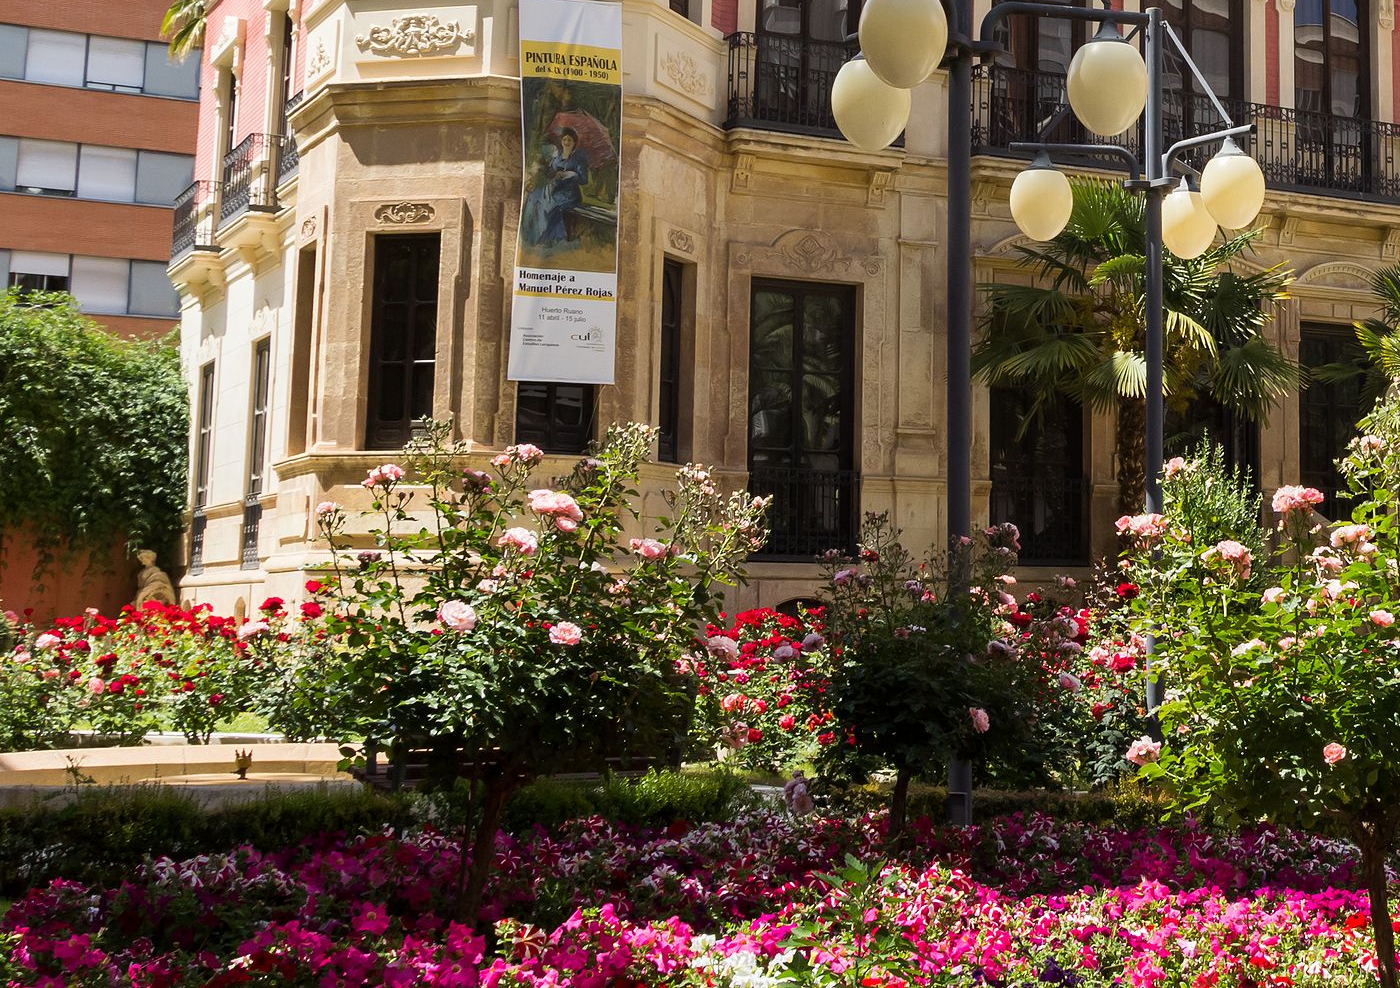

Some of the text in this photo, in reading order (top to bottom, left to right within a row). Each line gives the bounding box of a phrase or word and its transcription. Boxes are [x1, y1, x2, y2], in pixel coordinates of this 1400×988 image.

[525, 52, 618, 71] PINTURA ESPAÑOLA
[535, 65, 546, 73] del
[589, 70, 609, 80] 1950)
[519, 270, 567, 283] Homenaje
[519, 283, 613, 299] Manuel Pérez Rojas
